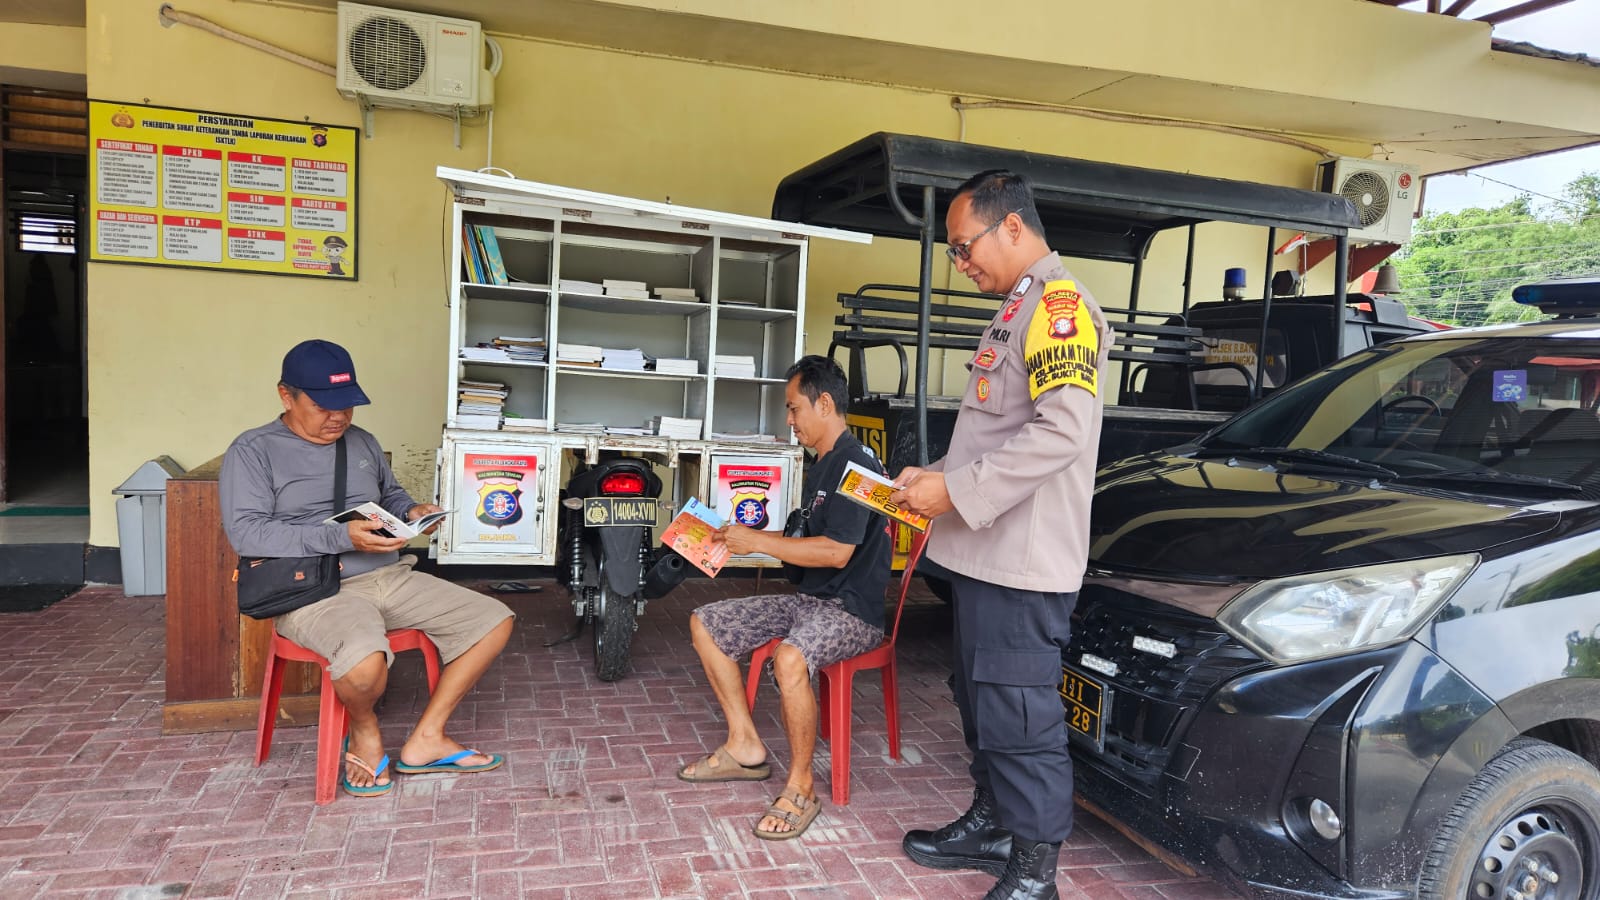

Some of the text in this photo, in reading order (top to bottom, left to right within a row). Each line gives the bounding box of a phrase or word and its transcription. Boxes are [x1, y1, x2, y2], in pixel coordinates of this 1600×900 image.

[198, 115, 254, 128] PERSYARATAN
[142, 120, 307, 144] PENERBITAN SURAT KETERANGAN TANDA LAPORAN KEHILANGAN
[182, 148, 202, 157] BPKB
[313, 161, 346, 171] TABUNGAN
[250, 194, 264, 203] SIM
[1397, 190, 1408, 200] LG
[324, 201, 337, 210] ATM
[184, 218, 200, 227] KTP
[614, 502, 655, 520] 14004-XVIII
[1072, 706, 1090, 732] 28
